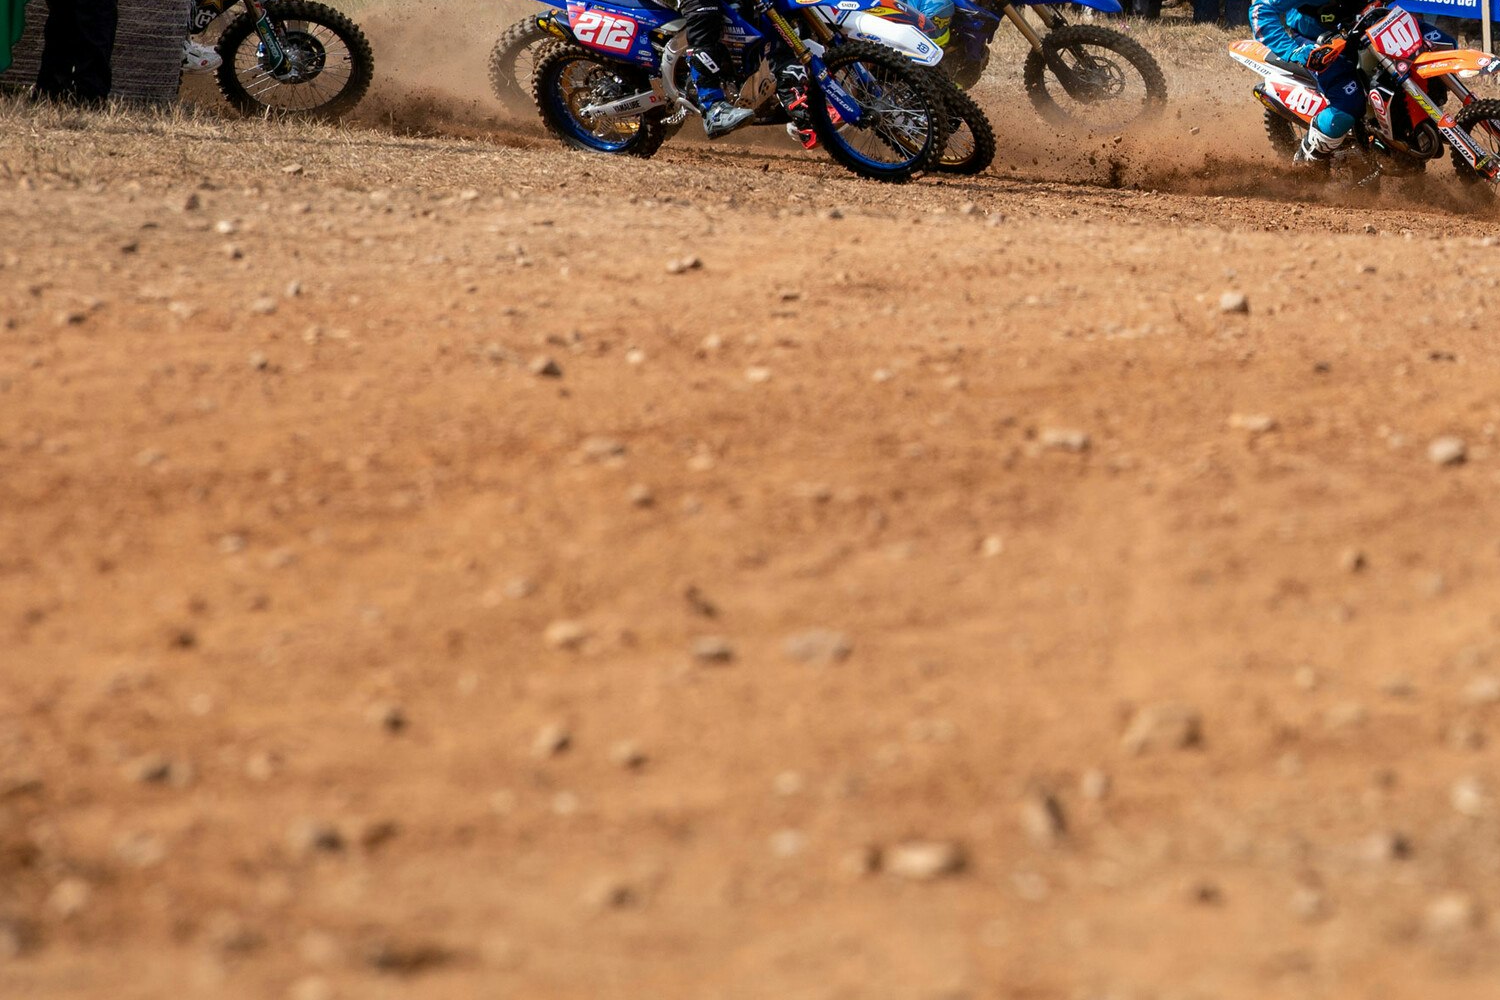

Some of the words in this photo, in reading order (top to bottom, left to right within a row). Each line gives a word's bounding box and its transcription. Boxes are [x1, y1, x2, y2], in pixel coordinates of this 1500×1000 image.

[573, 10, 635, 50] 212
[1381, 18, 1421, 57] 407
[1244, 58, 1272, 76] DUNLOP
[1285, 87, 1322, 117] 407
